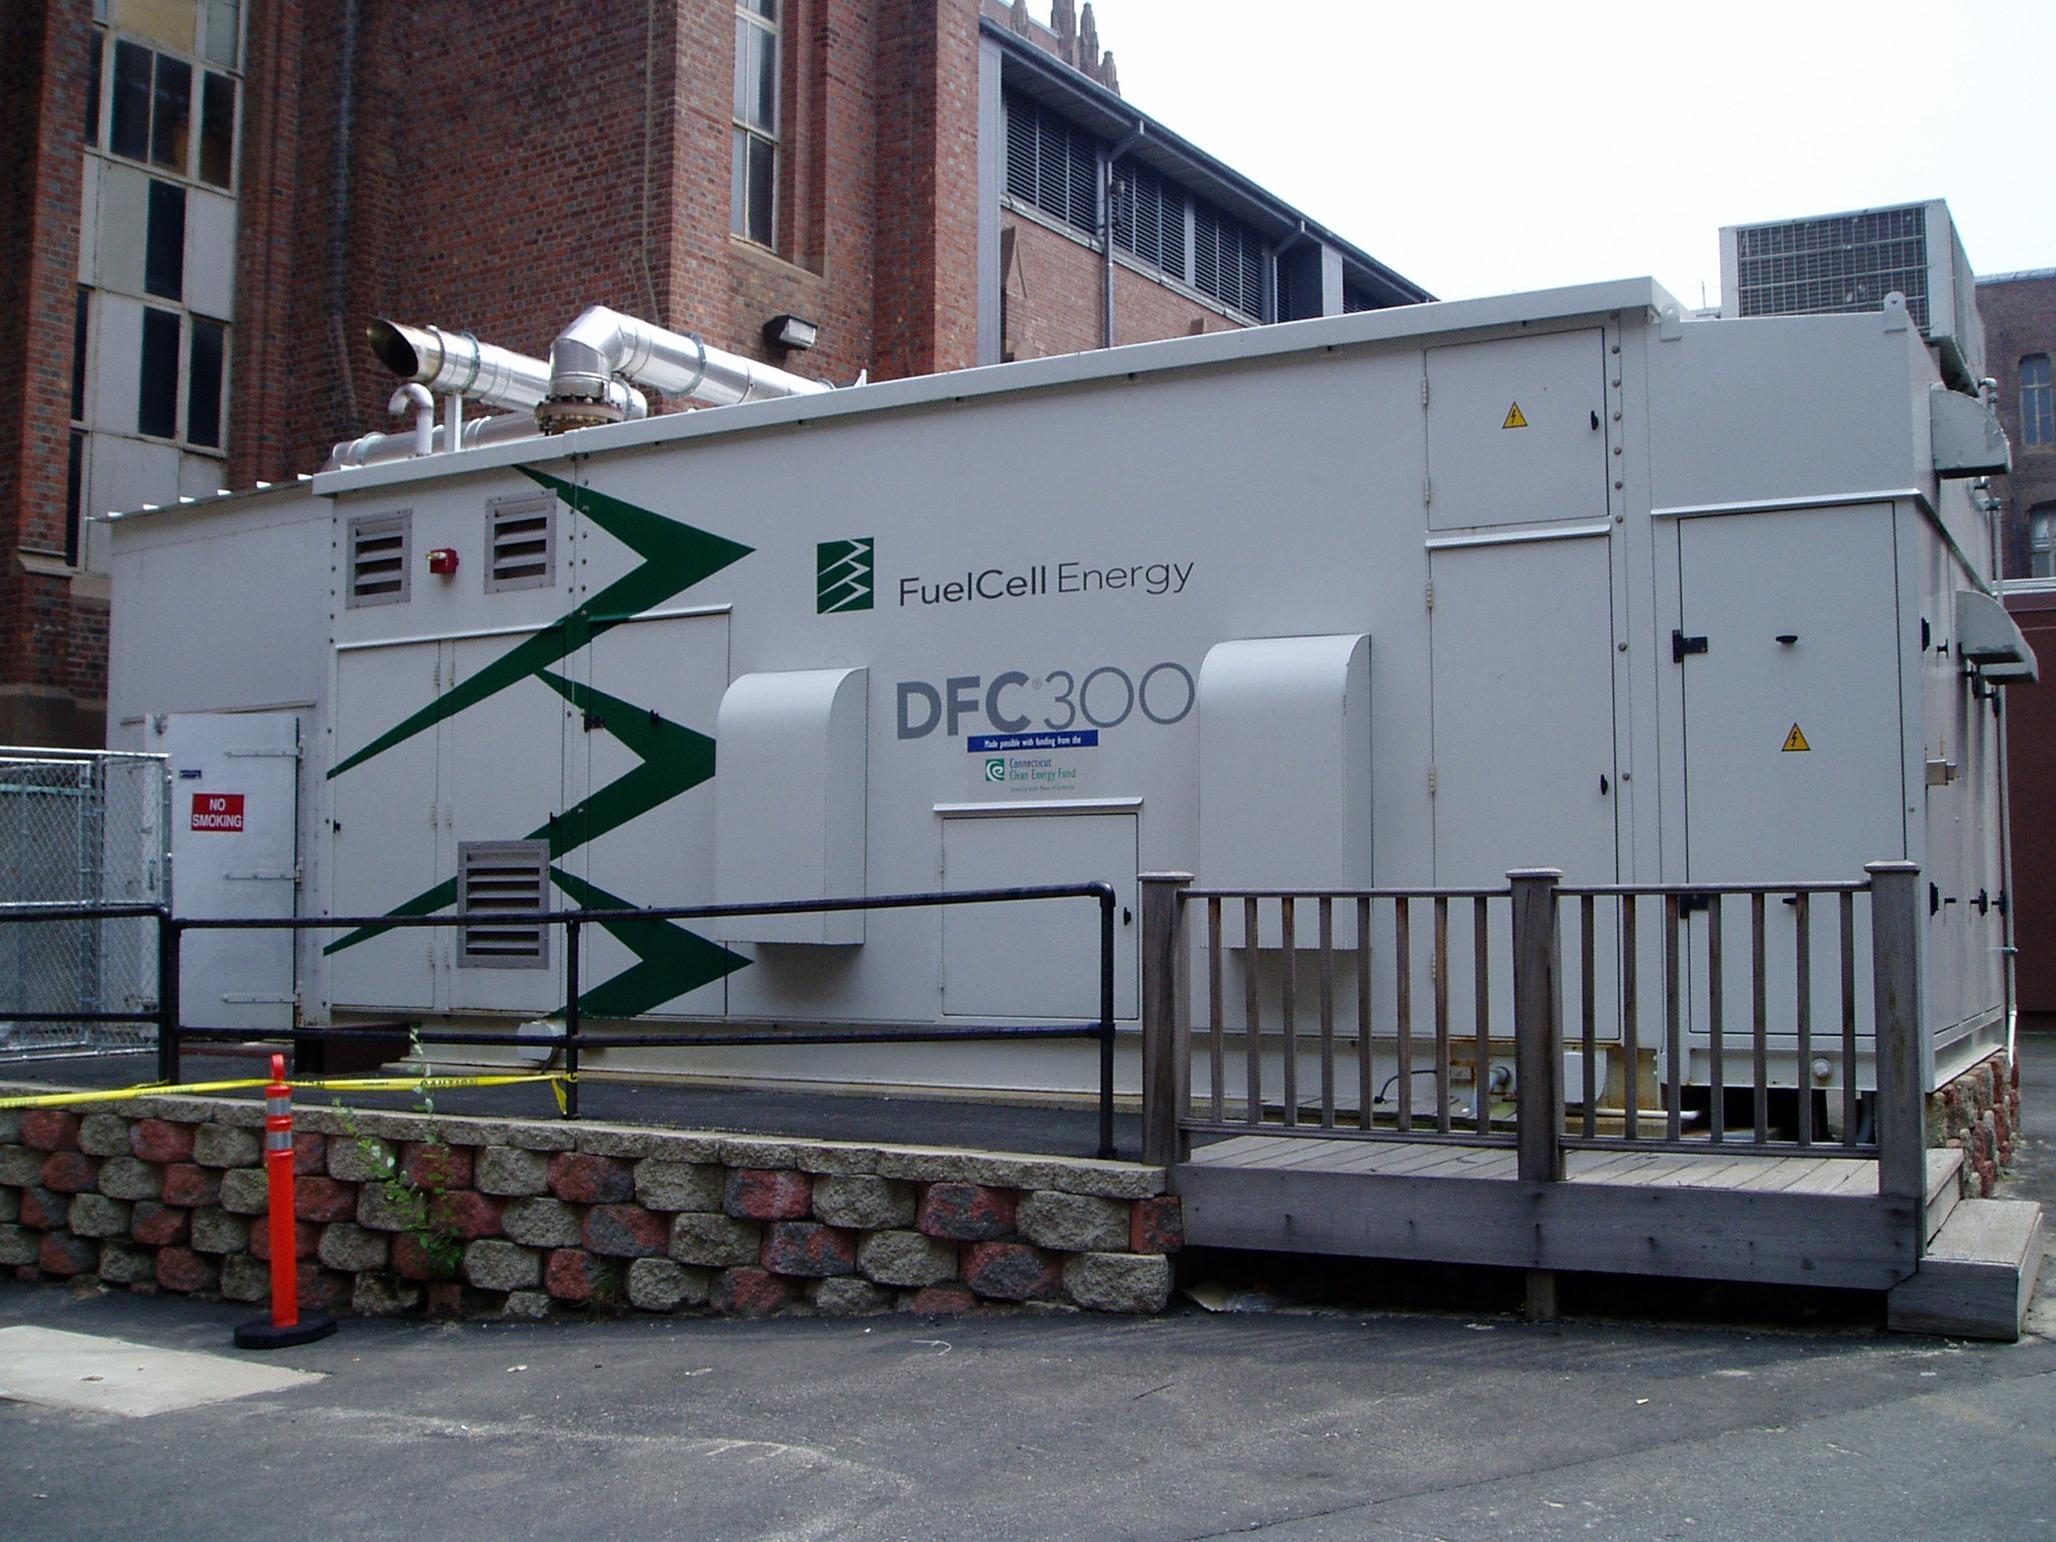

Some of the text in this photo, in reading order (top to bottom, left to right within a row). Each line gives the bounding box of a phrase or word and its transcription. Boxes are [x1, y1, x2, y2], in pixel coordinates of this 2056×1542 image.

[899, 561, 1194, 607] FuelCell Energy
[1022, 737, 1034, 746] with
[1035, 736, 1056, 748] funding
[1058, 735, 1071, 744] from
[1009, 758, 1053, 768] Connecticut
[1009, 769, 1028, 780] Clean
[1032, 767, 1055, 781] Energy
[209, 798, 226, 811] NO
[192, 814, 242, 827] SMOKING
